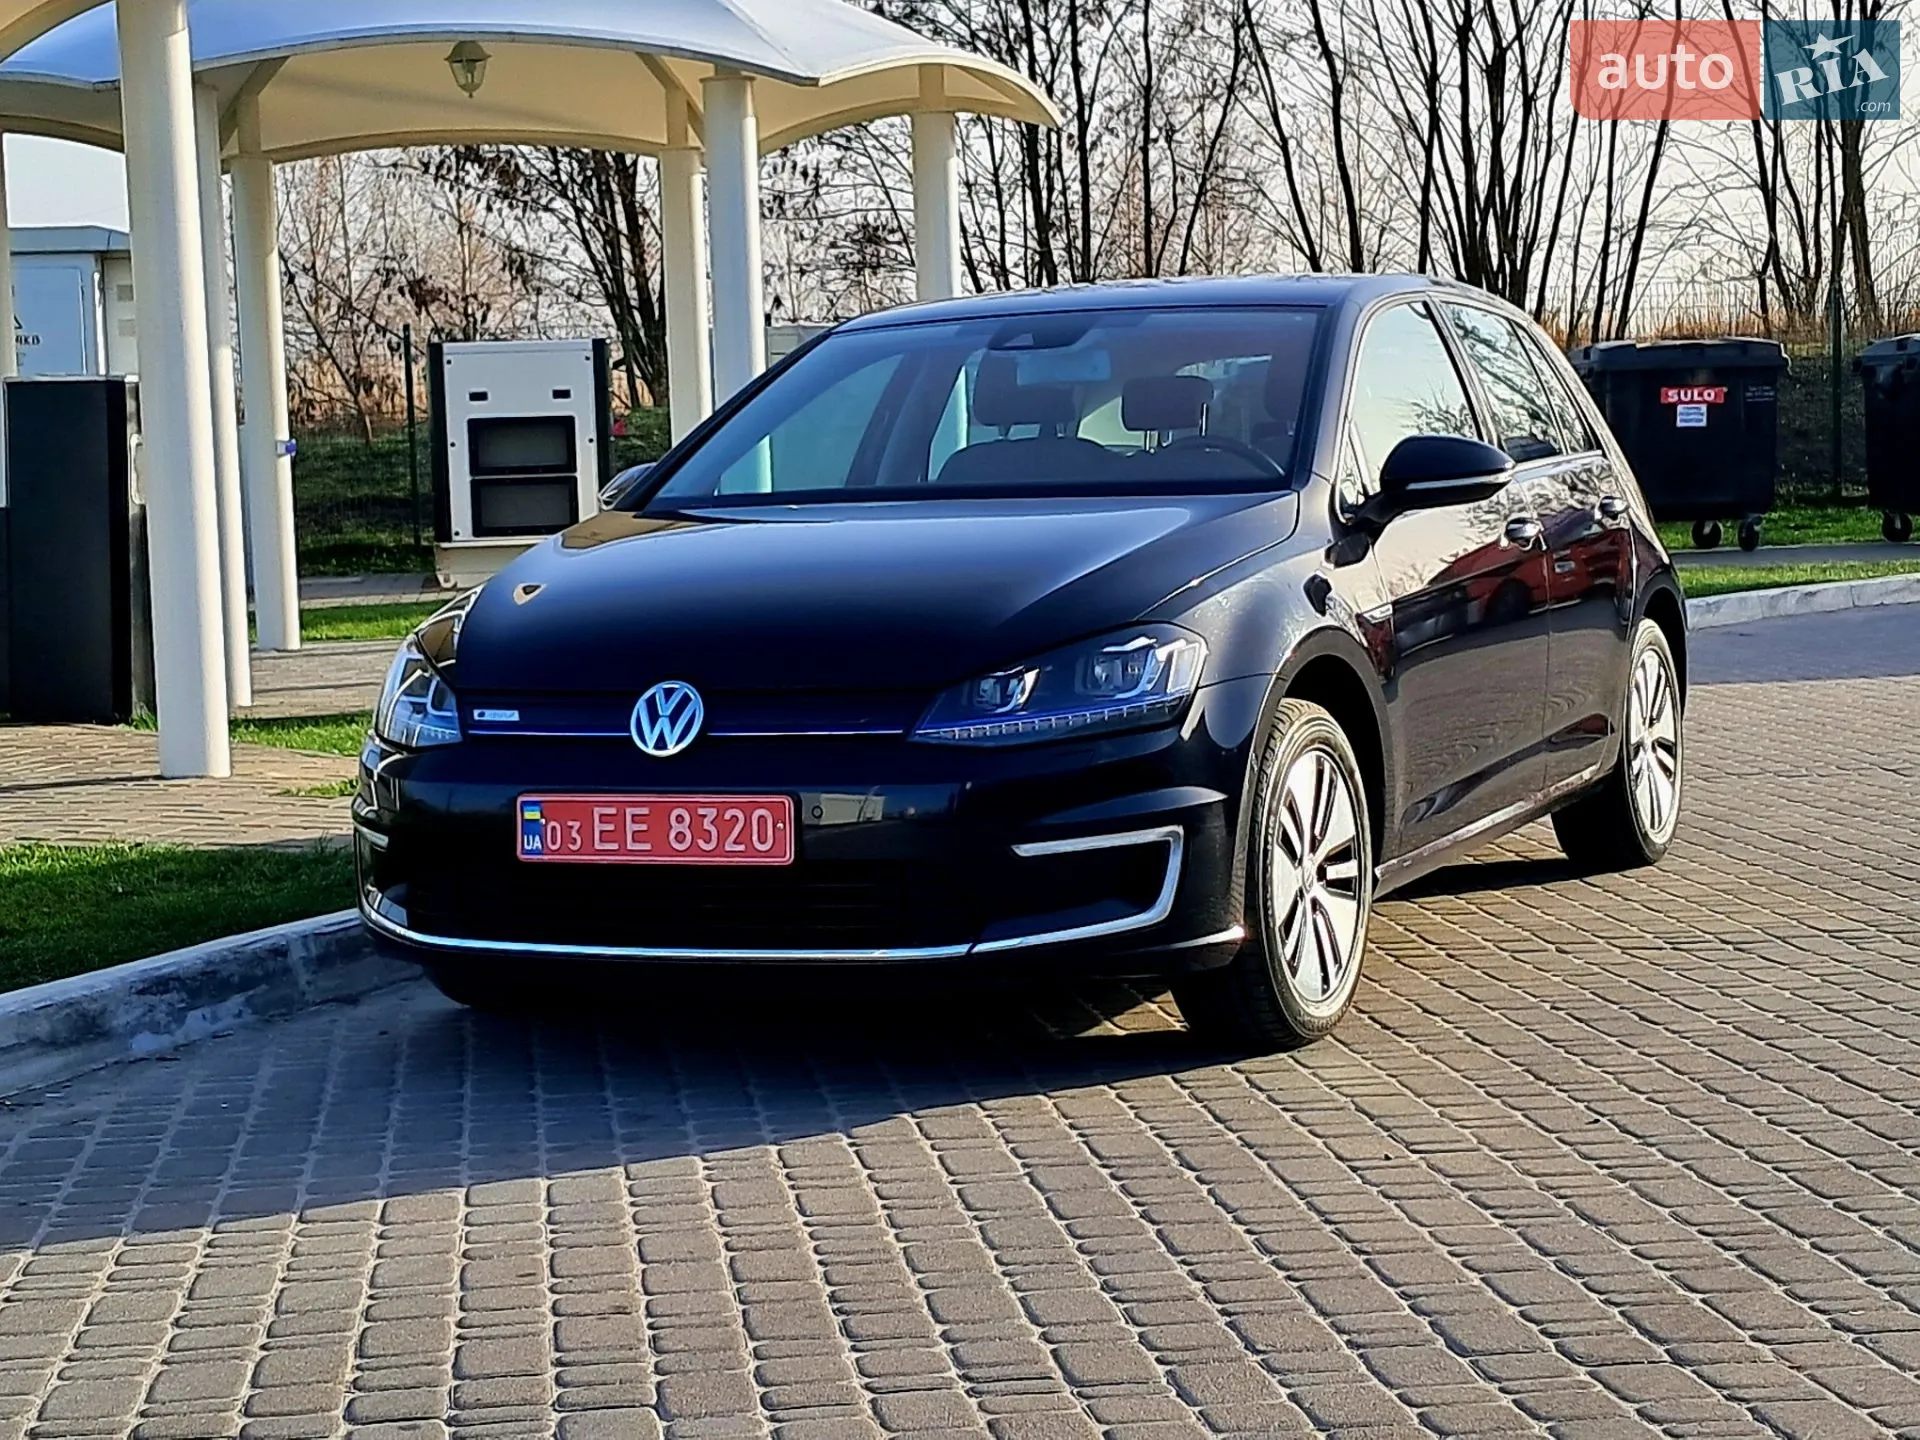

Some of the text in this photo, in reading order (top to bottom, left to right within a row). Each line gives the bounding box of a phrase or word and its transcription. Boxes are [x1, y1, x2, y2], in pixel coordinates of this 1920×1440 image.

[1667, 389, 1716, 402] SULO
[632, 681, 703, 756] VW
[524, 835, 542, 850] UA
[546, 807, 775, 852] 03 EE 8320
